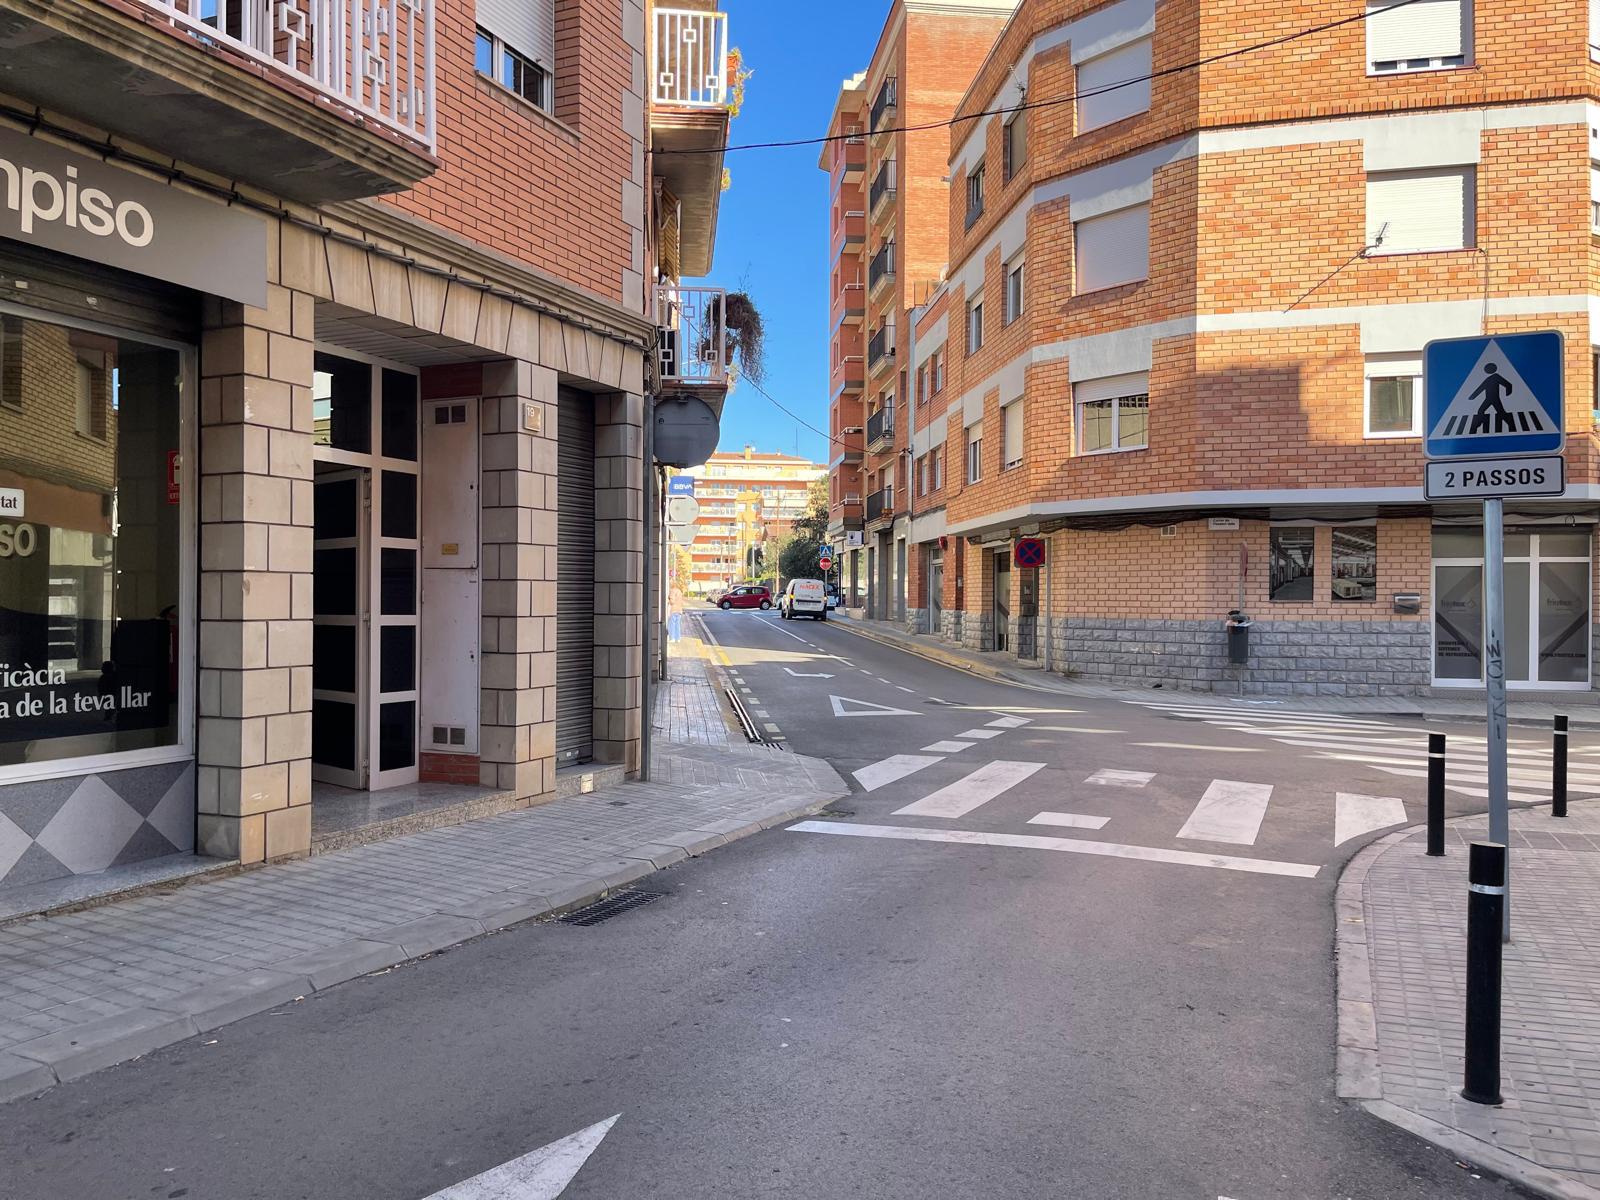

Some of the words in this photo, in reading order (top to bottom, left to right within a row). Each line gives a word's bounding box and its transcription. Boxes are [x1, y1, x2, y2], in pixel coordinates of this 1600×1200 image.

[527, 406, 535, 417] 19
[1444, 471, 1456, 488] 2
[1462, 467, 1545, 487] PASSOS
[16, 692, 43, 717] de
[50, 690, 68, 715] la
[73, 691, 116, 713] teva
[121, 685, 152, 709] llar
